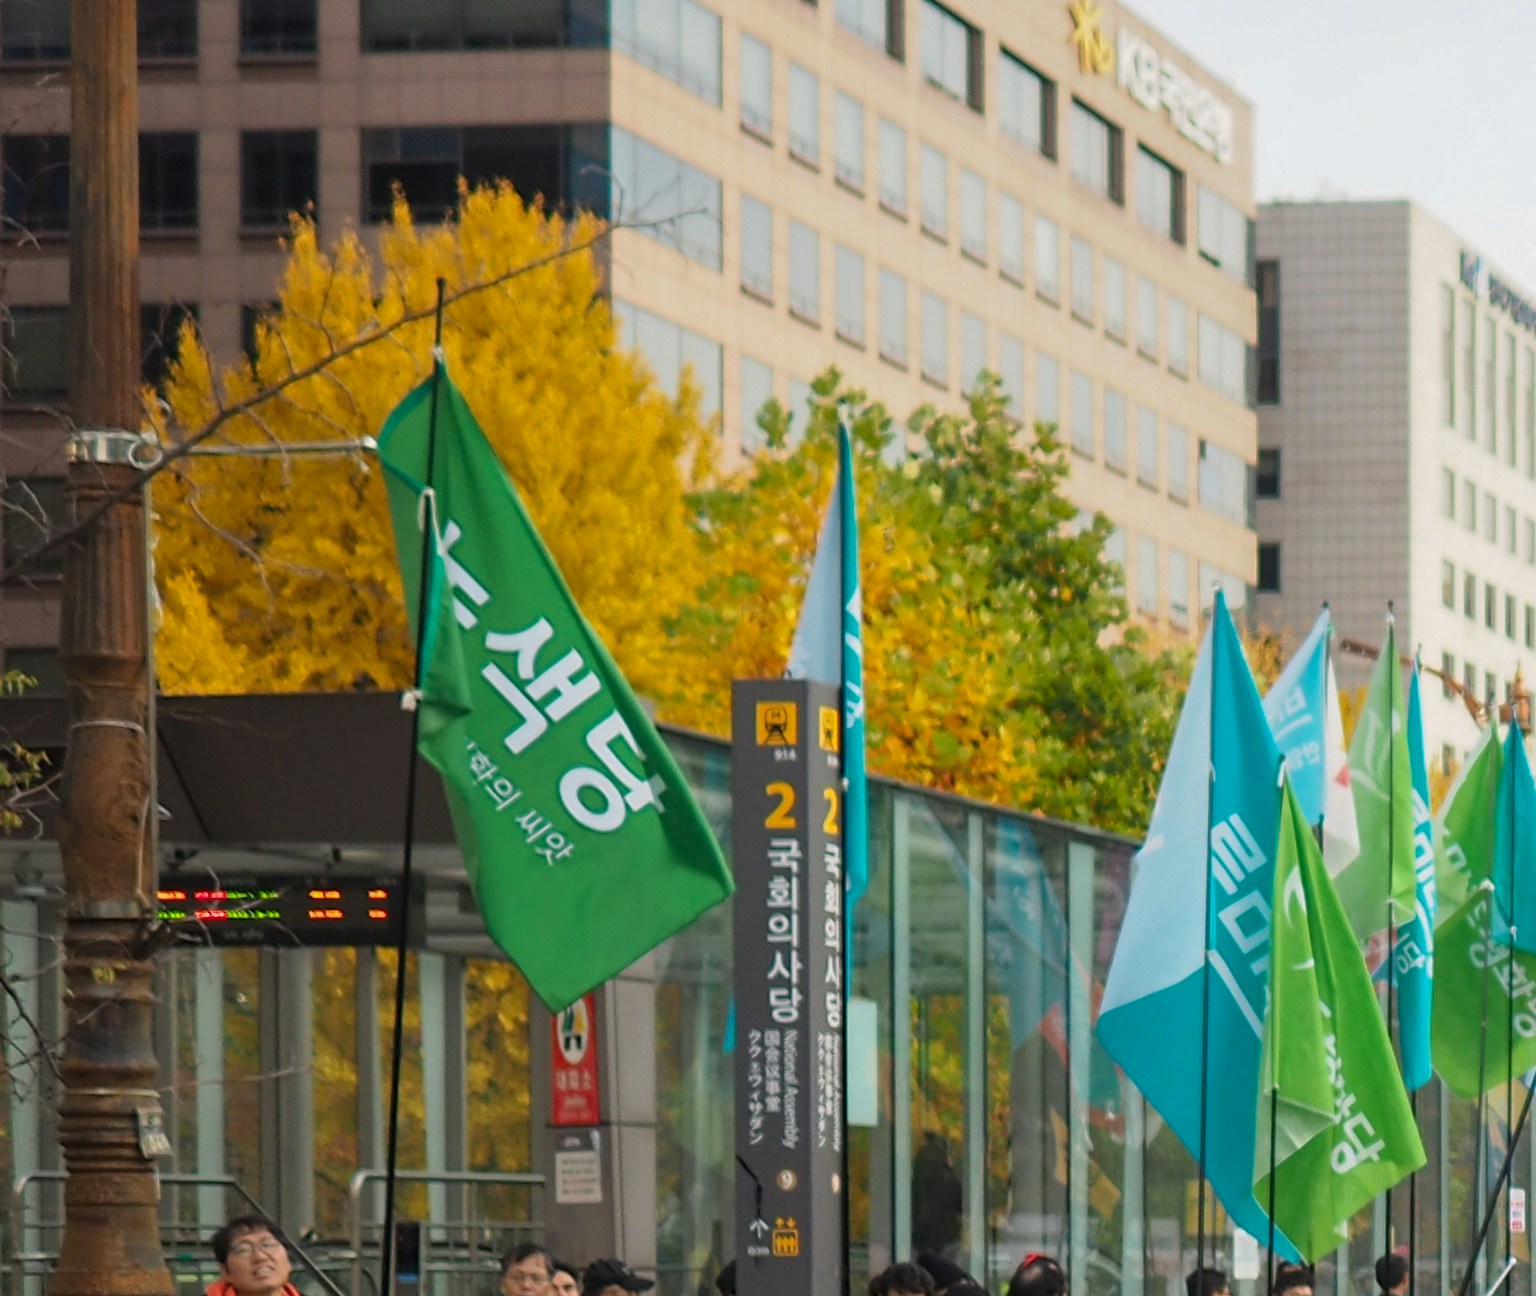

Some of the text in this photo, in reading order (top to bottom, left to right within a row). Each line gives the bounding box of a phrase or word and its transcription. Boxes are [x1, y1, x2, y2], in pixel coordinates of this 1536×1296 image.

[765, 781, 797, 829] 2
[823, 787, 839, 835] 2
[767, 838, 803, 1024] 국회의사당
